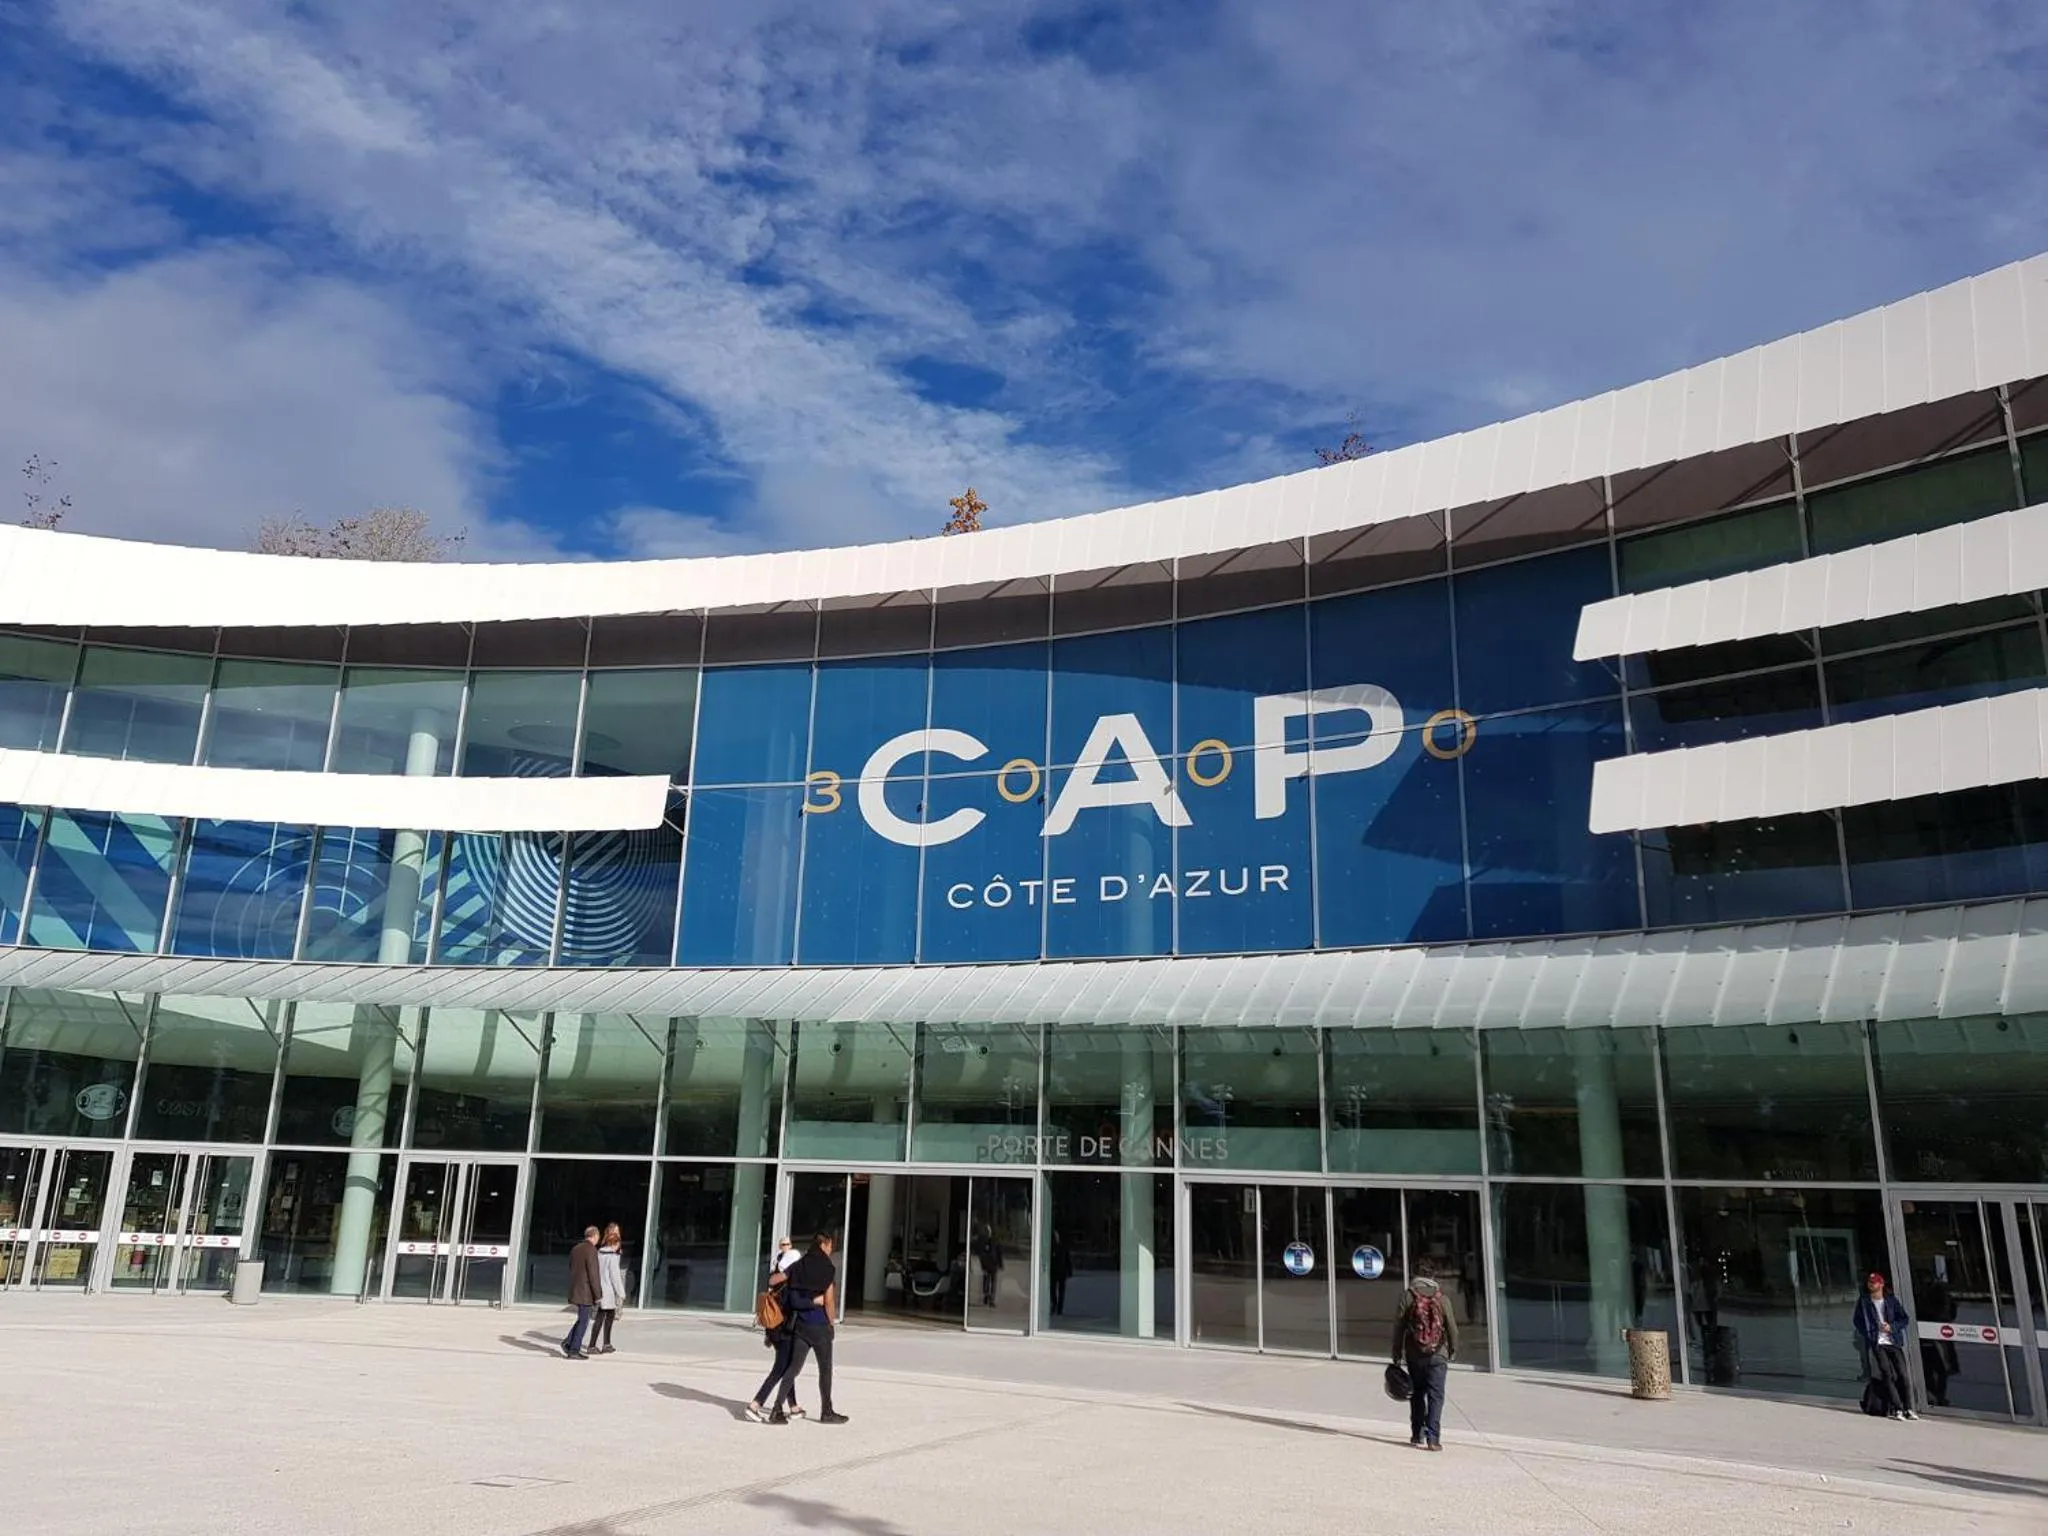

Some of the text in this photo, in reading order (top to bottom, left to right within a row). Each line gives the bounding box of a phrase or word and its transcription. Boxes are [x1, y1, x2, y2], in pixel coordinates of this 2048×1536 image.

[947, 874, 1077, 909] CÔTE
[988, 1135, 1069, 1157] PORTE
[1080, 1136, 1112, 1158] DE
[1119, 1137, 1229, 1160] CANNES
